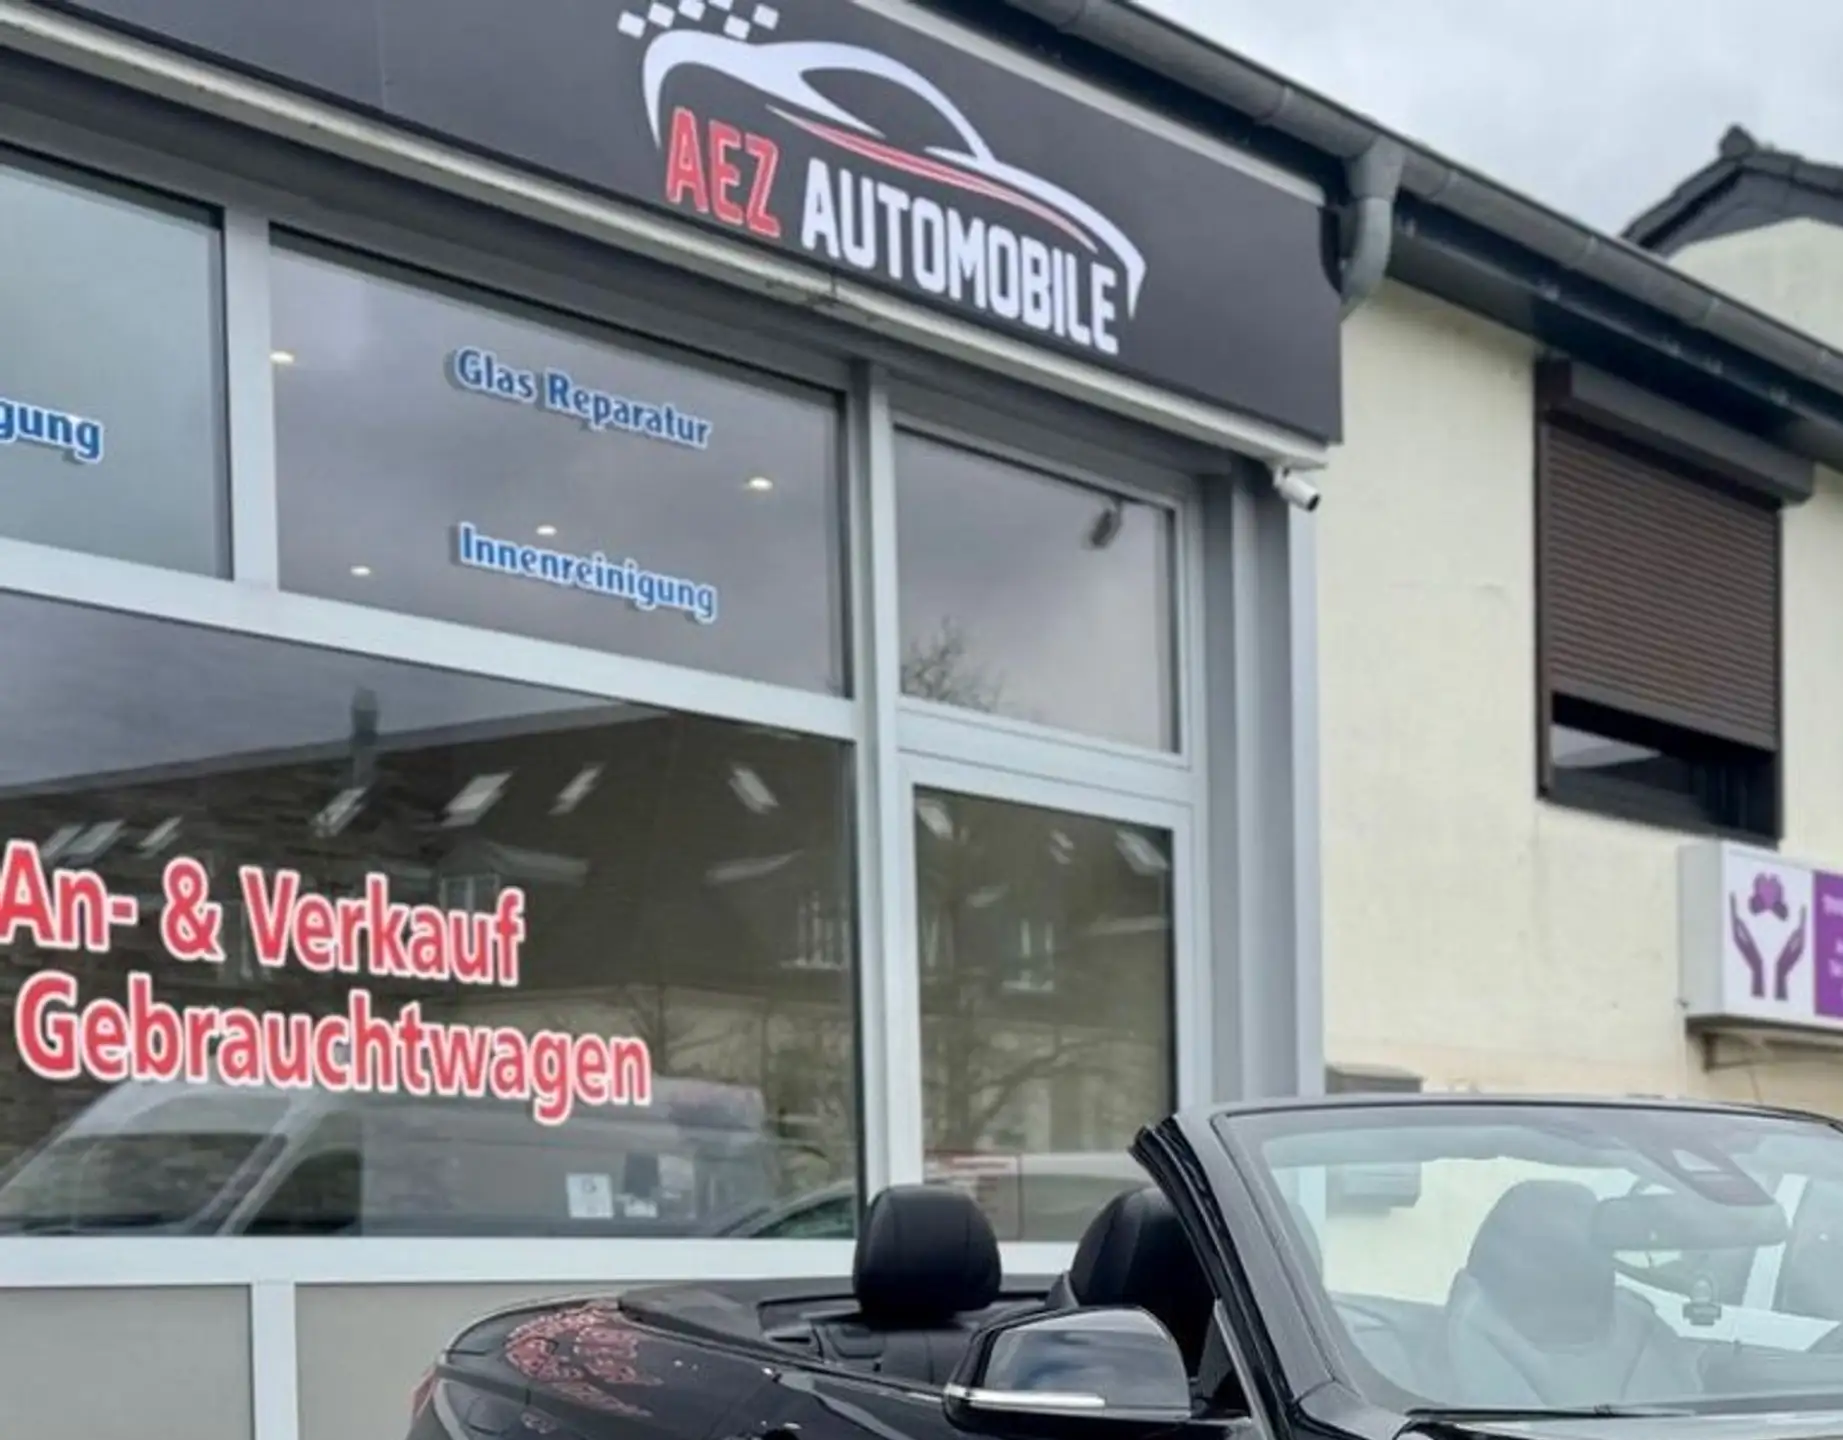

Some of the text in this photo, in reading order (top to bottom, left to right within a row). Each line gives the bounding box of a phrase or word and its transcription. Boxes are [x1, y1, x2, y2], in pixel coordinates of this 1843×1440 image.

[666, 106, 1119, 355] AEZ AUTOMOBILE
[456, 346, 713, 449] Glas Reparatur
[459, 520, 717, 624] Innenreinigung
[0, 839, 525, 986] An- & Verkauf
[15, 971, 651, 1125] Gebrauchtwagen
